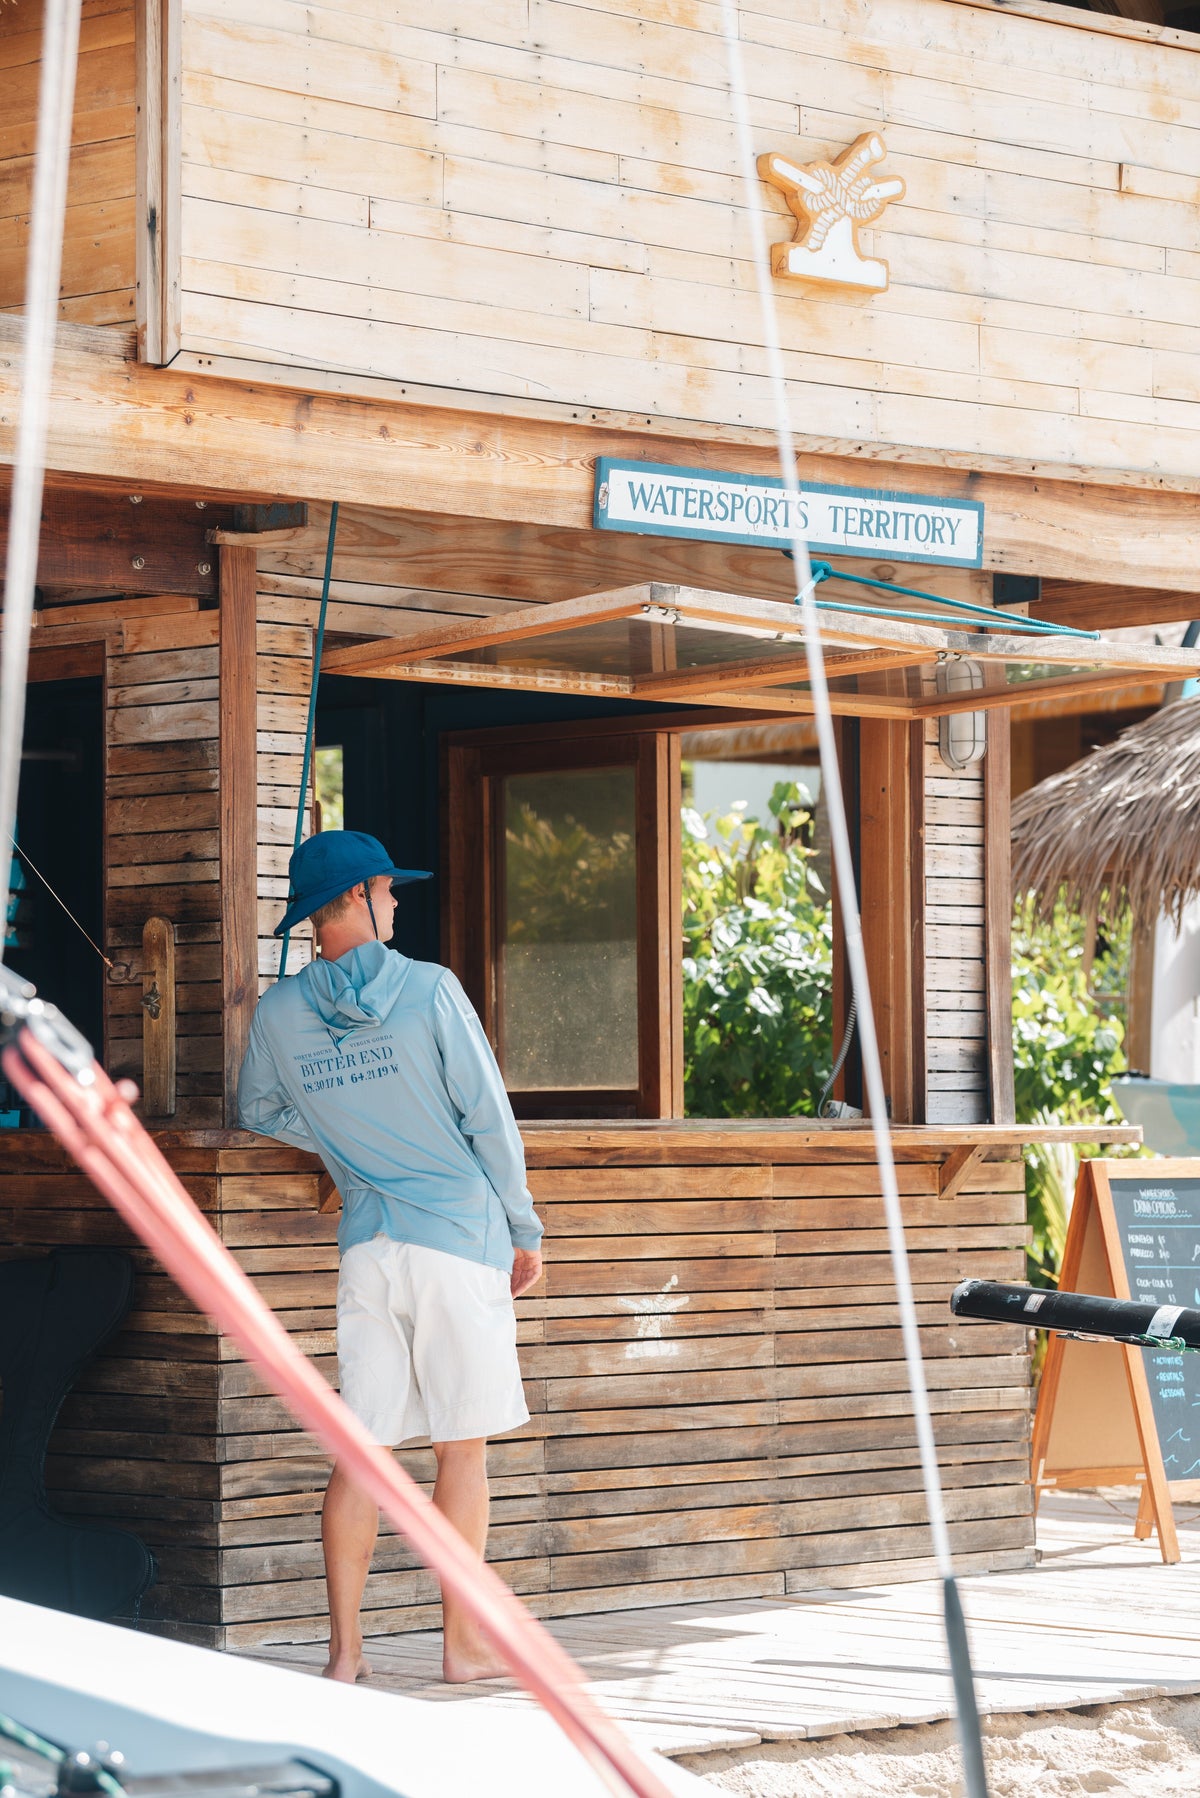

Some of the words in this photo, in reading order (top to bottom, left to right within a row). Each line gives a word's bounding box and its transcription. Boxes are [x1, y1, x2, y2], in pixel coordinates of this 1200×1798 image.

[628, 481, 809, 530] WATERSPORTS
[828, 505, 962, 546] TERRITORY
[349, 1039, 371, 1048] VIRGIN
[372, 1034, 394, 1043] GORDA
[300, 1053, 357, 1078] BITTER
[360, 1046, 393, 1065] END
[1136, 1277, 1165, 1288] COCA-COLA
[1159, 1371, 1185, 1382] RENTALS
[1161, 1387, 1186, 1398] LESSONS
